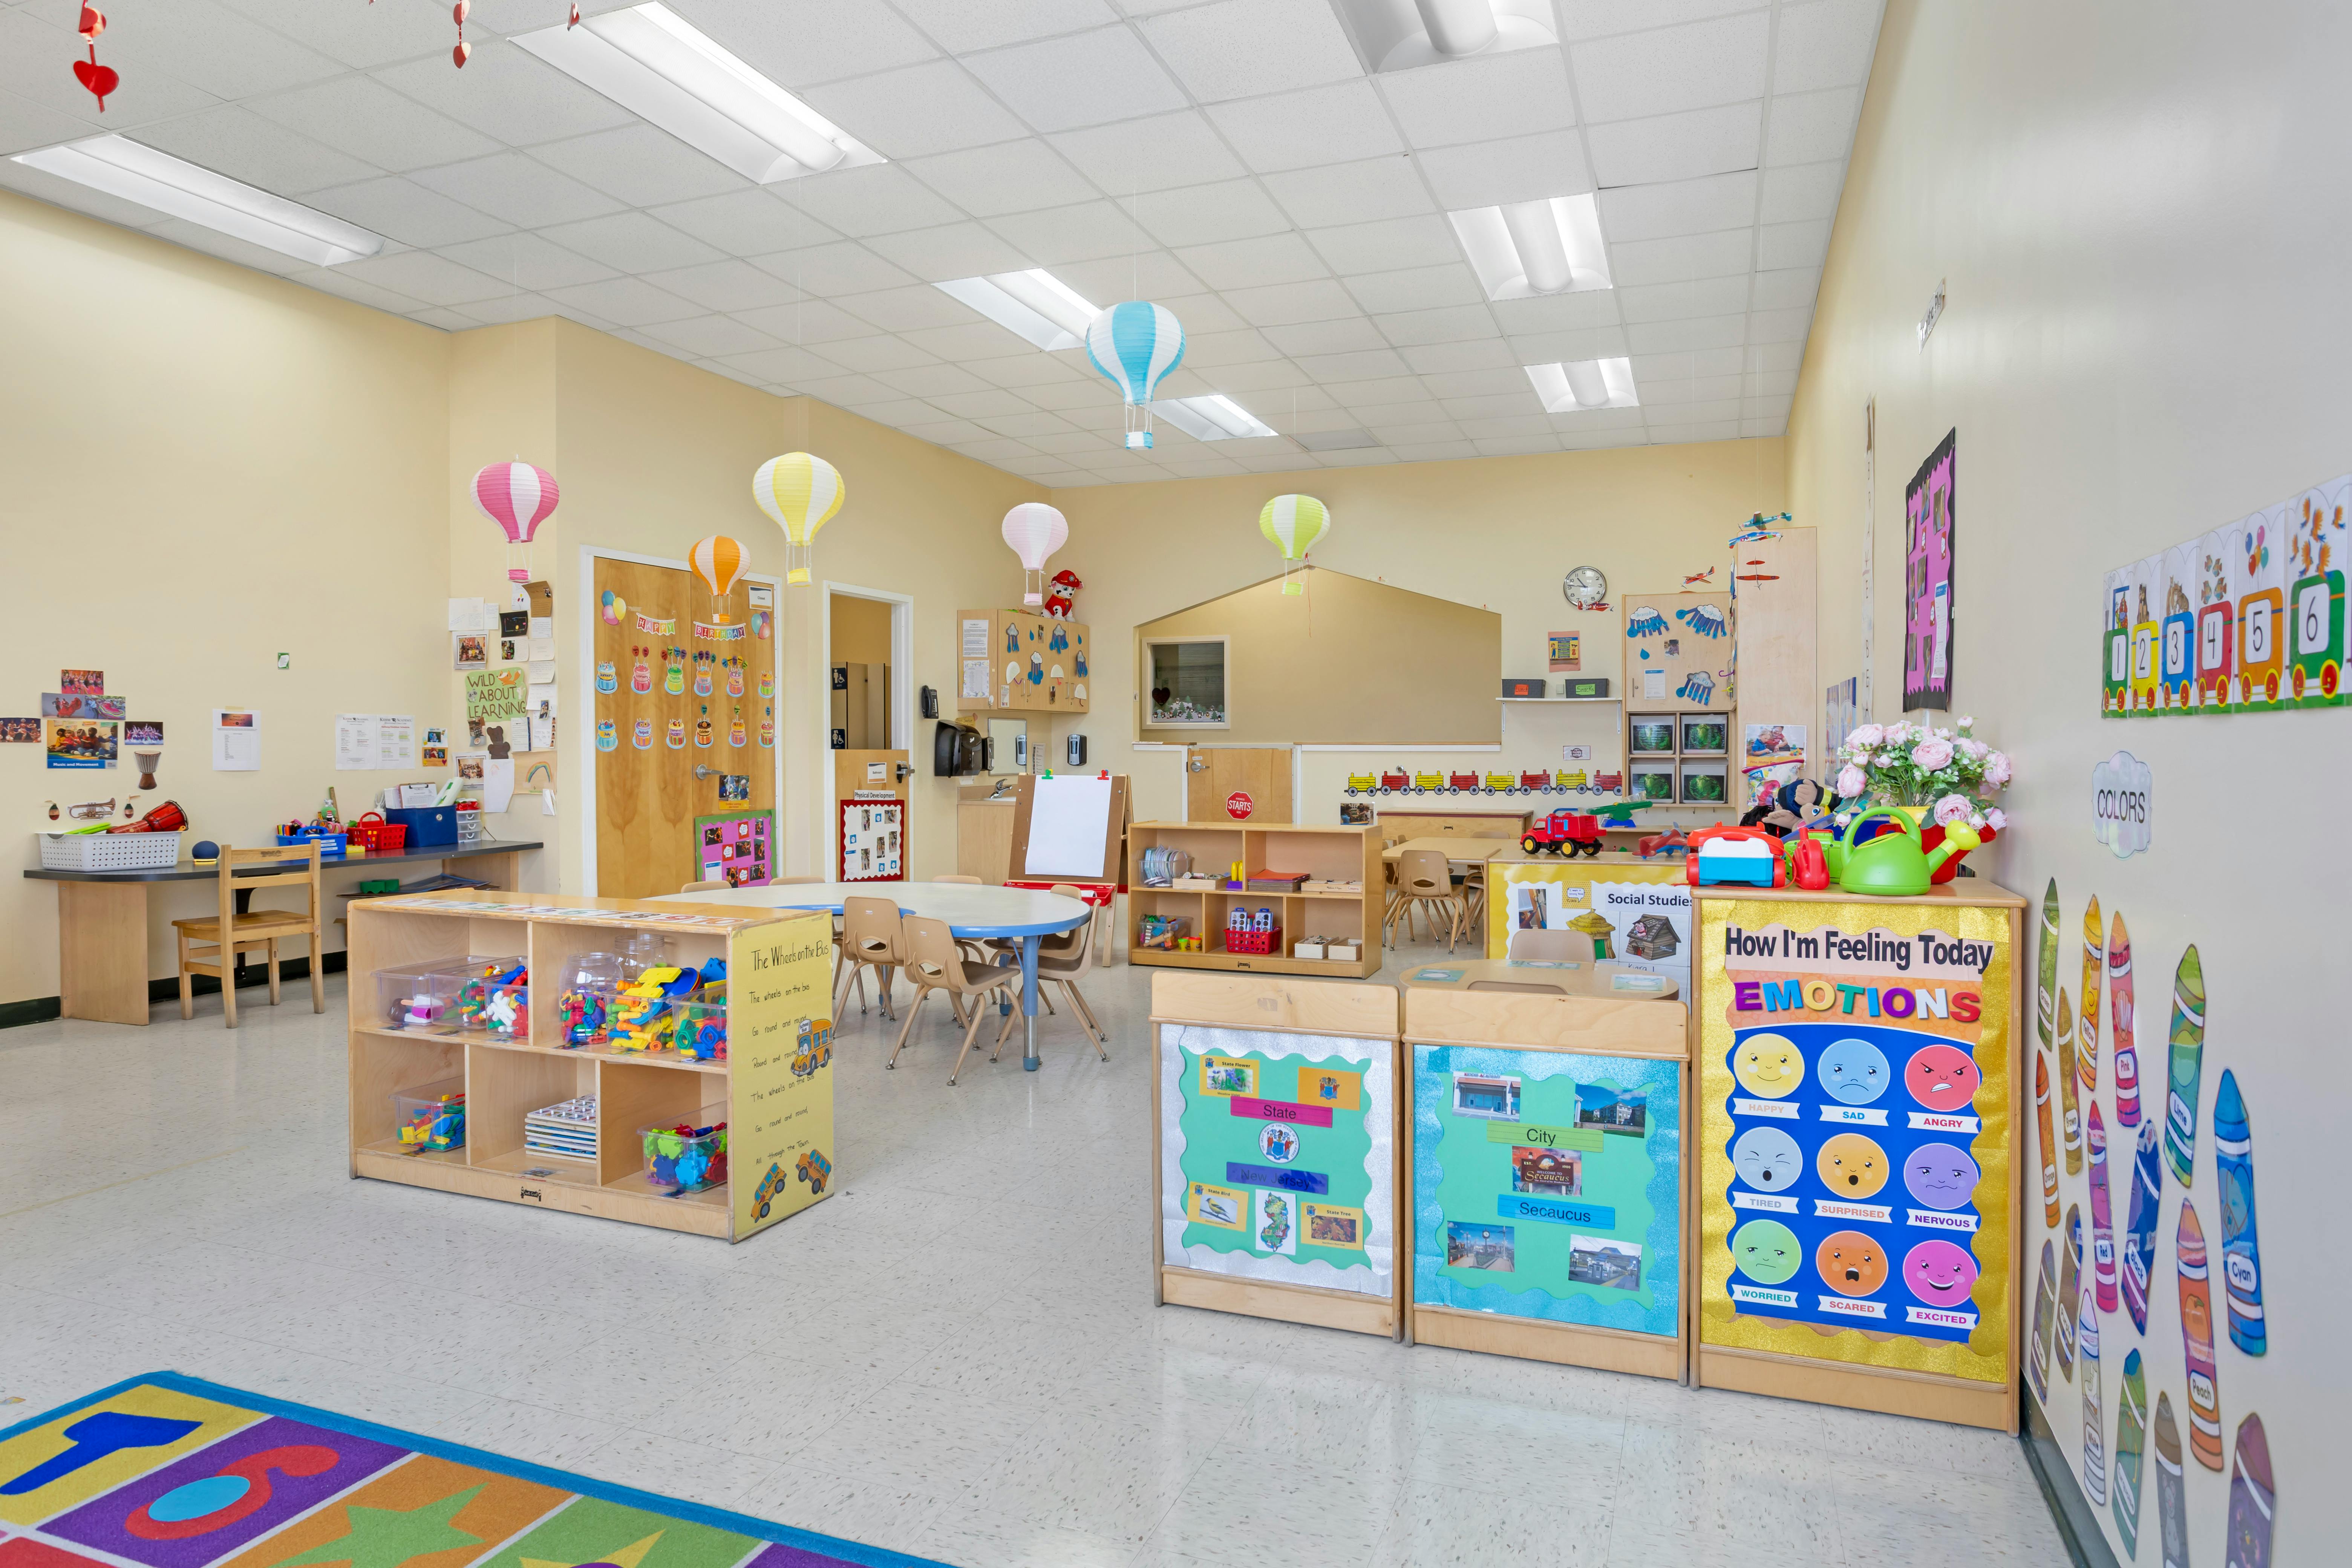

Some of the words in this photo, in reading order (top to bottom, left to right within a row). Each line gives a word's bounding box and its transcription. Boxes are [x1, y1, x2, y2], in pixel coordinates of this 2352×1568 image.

[639, 619, 672, 631] HAPPY
[697, 626, 743, 637] BIRTHDAY
[2306, 596, 2318, 642] 6
[2207, 620, 2215, 659] 4
[2252, 610, 2263, 652] 5
[2139, 638, 2145, 670] 2
[2171, 631, 2178, 665] 3
[479, 686, 517, 702] ABOUT
[1228, 800, 1251, 811] STARTS
[2097, 788, 2145, 824] COLORS
[1608, 894, 1644, 904] Social
[751, 949, 768, 971] The
[771, 942, 796, 966] Wheels
[798, 951, 804, 961] on
[805, 945, 814, 959] the
[816, 940, 828, 957] Bus
[1725, 927, 1776, 957] How
[1783, 930, 1818, 959] I'm
[1825, 931, 1911, 971] Feeling
[1919, 934, 1993, 975] Today
[749, 991, 760, 1003] The
[764, 988, 781, 1001] wheels
[1733, 980, 1981, 1023] EMOTIONS
[2041, 990, 2050, 1008] Green
[752, 1027, 758, 1036] Go
[765, 1022, 777, 1033] round
[782, 1019, 791, 1027] and
[2083, 1021, 2094, 1043] Yellow
[752, 1057, 767, 1068] Round
[2121, 1060, 2130, 1072] Pink
[750, 1091, 763, 1102] The
[769, 1084, 785, 1096] wheels
[769, 1117, 781, 1127] round
[796, 1106, 808, 1116] round,
[1263, 1105, 1296, 1119] State
[1749, 1103, 1785, 1115] HAPPY
[1842, 1110, 1865, 1121] SAD
[1923, 1117, 1963, 1129] ANGRY
[2066, 1117, 2077, 1127] Brown
[2174, 1099, 2187, 1124] Lime
[1527, 1129, 1556, 1146] City
[768, 1149, 785, 1161] through
[1241, 1168, 1266, 1181] New
[1271, 1173, 1311, 1190] Jersey
[1525, 1171, 1569, 1182] Secaucus
[2044, 1171, 2055, 1183] Orange
[1519, 1202, 1591, 1222] Secaucus
[1749, 1198, 1782, 1210] TIRED
[1821, 1205, 1885, 1220] SURPRISED
[1914, 1214, 1971, 1228] NERVOUS
[2130, 1249, 2144, 1282] Black
[2232, 1262, 2252, 1283] Cyan
[1741, 1289, 1792, 1303] WORRIED
[1829, 1300, 1876, 1313] SCARED
[1916, 1311, 1967, 1325] EXCITED
[2192, 1379, 2212, 1402] Peach
[2087, 1430, 2099, 1450] White
